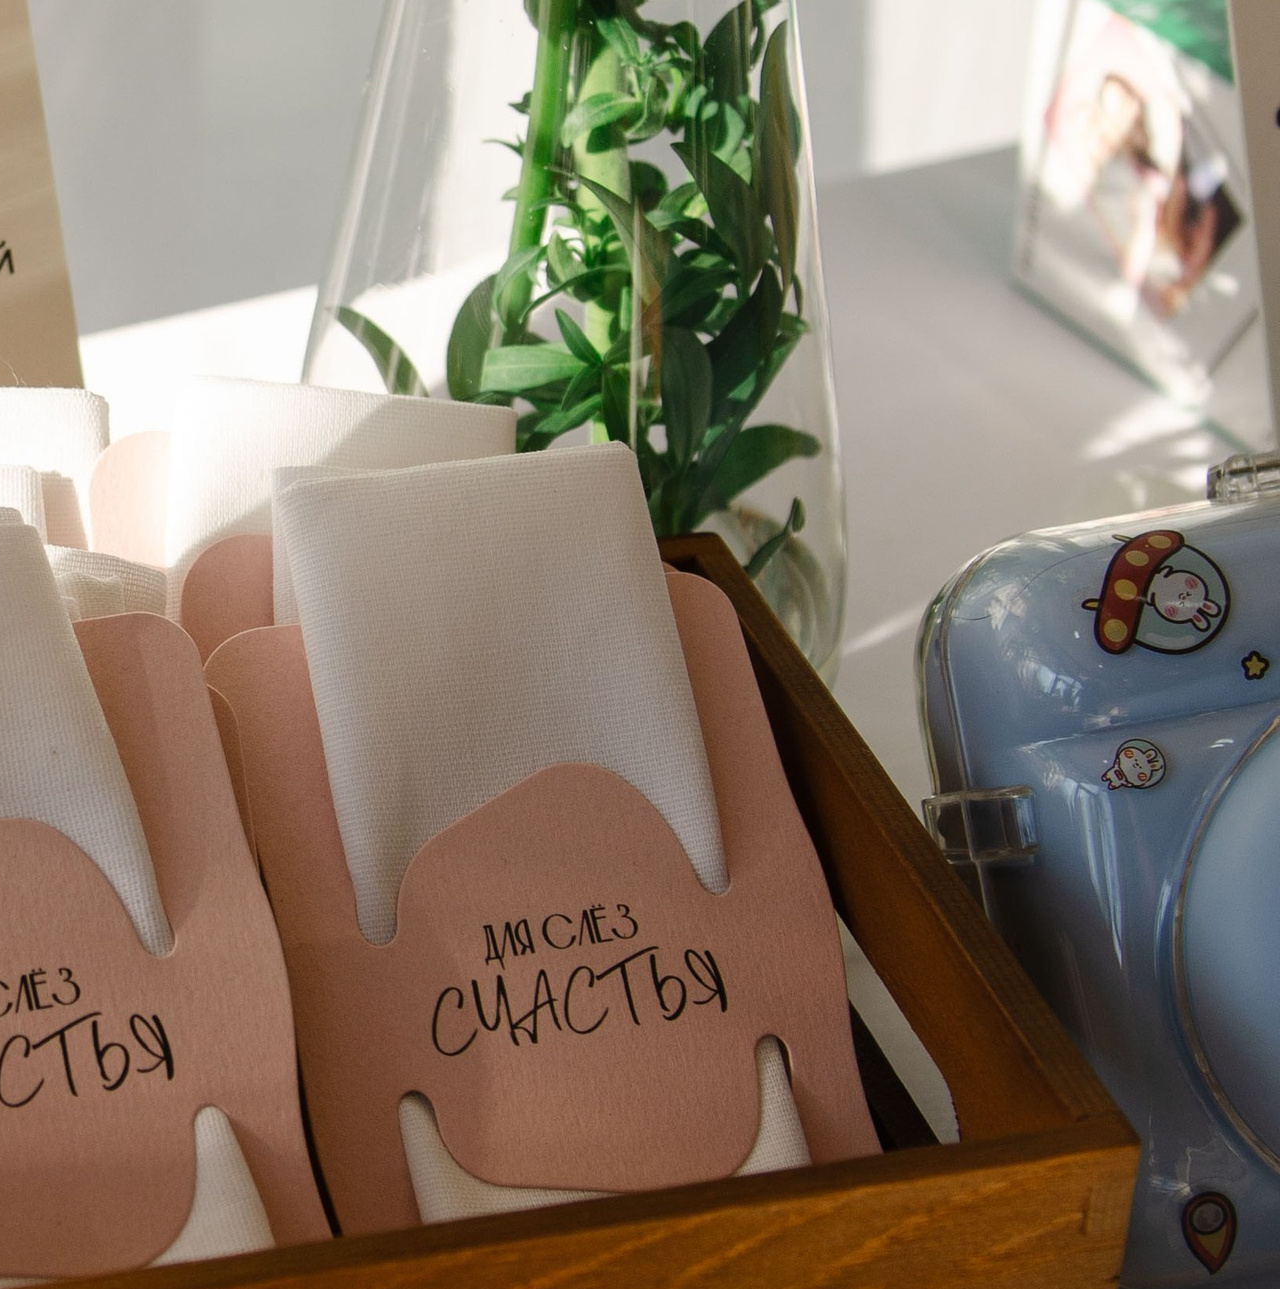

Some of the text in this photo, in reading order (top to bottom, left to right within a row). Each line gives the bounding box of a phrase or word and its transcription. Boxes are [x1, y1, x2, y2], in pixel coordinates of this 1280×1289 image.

[482, 903, 639, 970] ДЛЯ СЛЁЗ
[431, 946, 728, 1057] СЧАСТЬЯ
